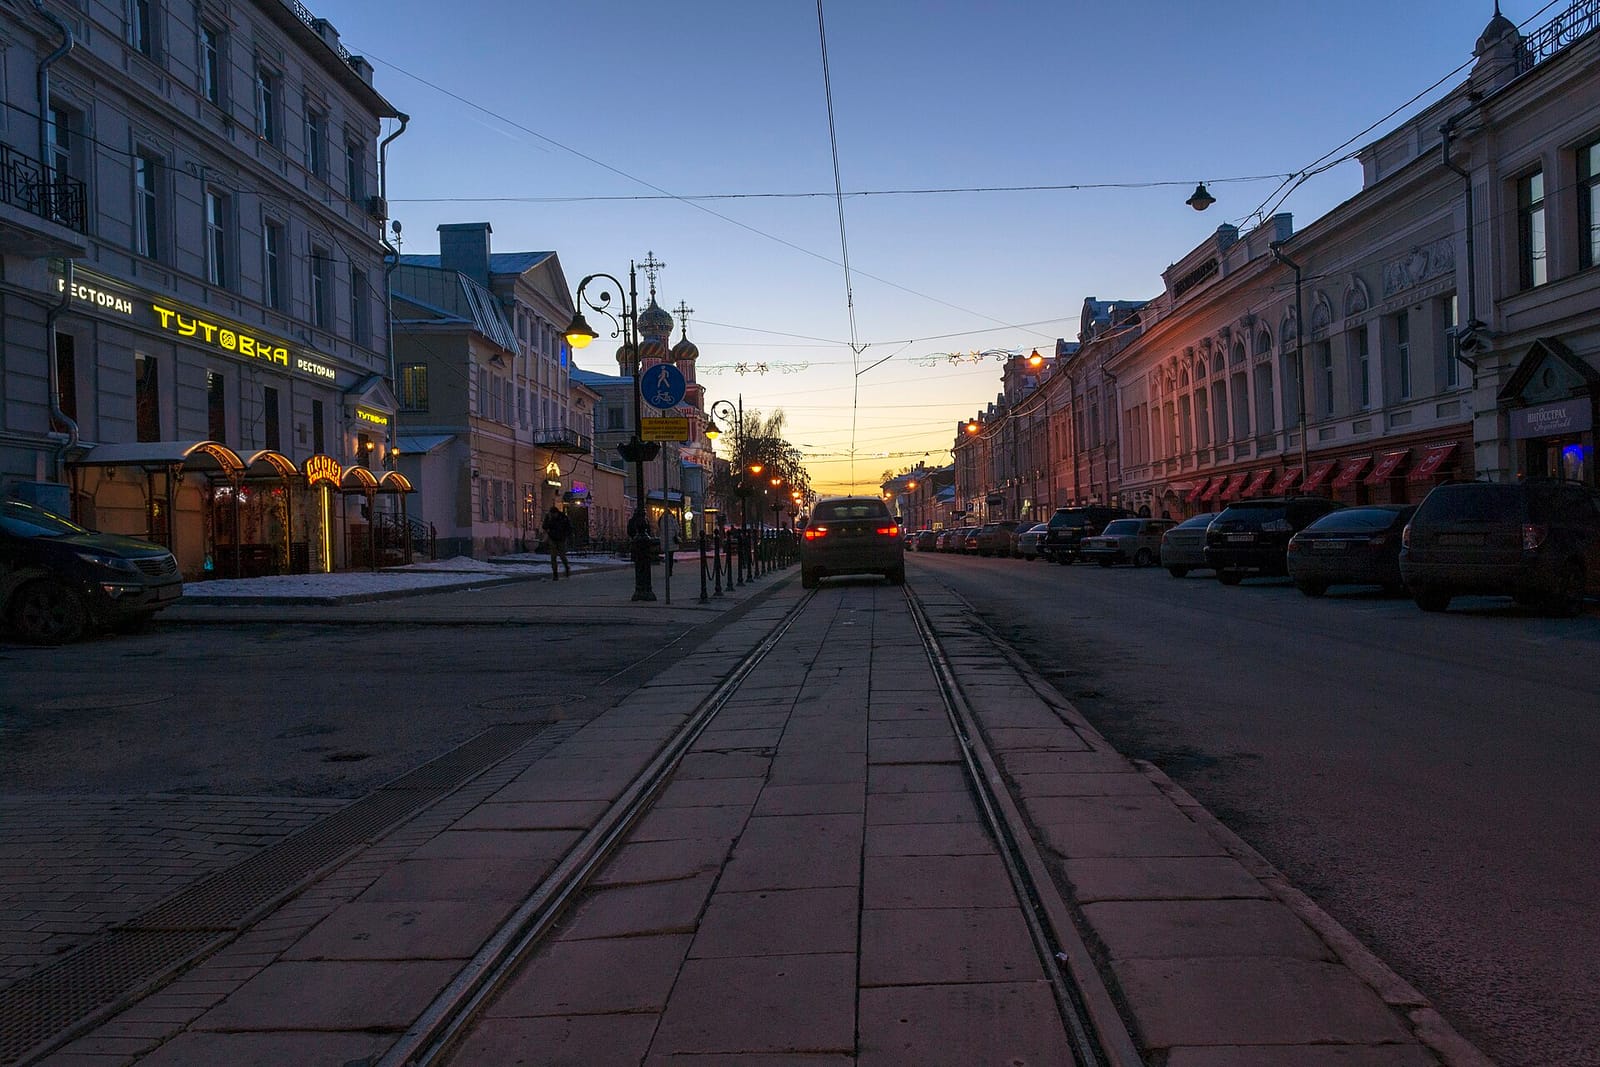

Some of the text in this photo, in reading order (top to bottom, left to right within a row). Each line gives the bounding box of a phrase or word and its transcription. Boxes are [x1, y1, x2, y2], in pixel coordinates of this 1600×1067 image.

[58, 279, 132, 314] РЕСТОРАН
[153, 305, 289, 366] ТУТОВКА
[297, 358, 336, 379] РЕСТОРАН
[357, 410, 388, 425] ТУТОВКА
